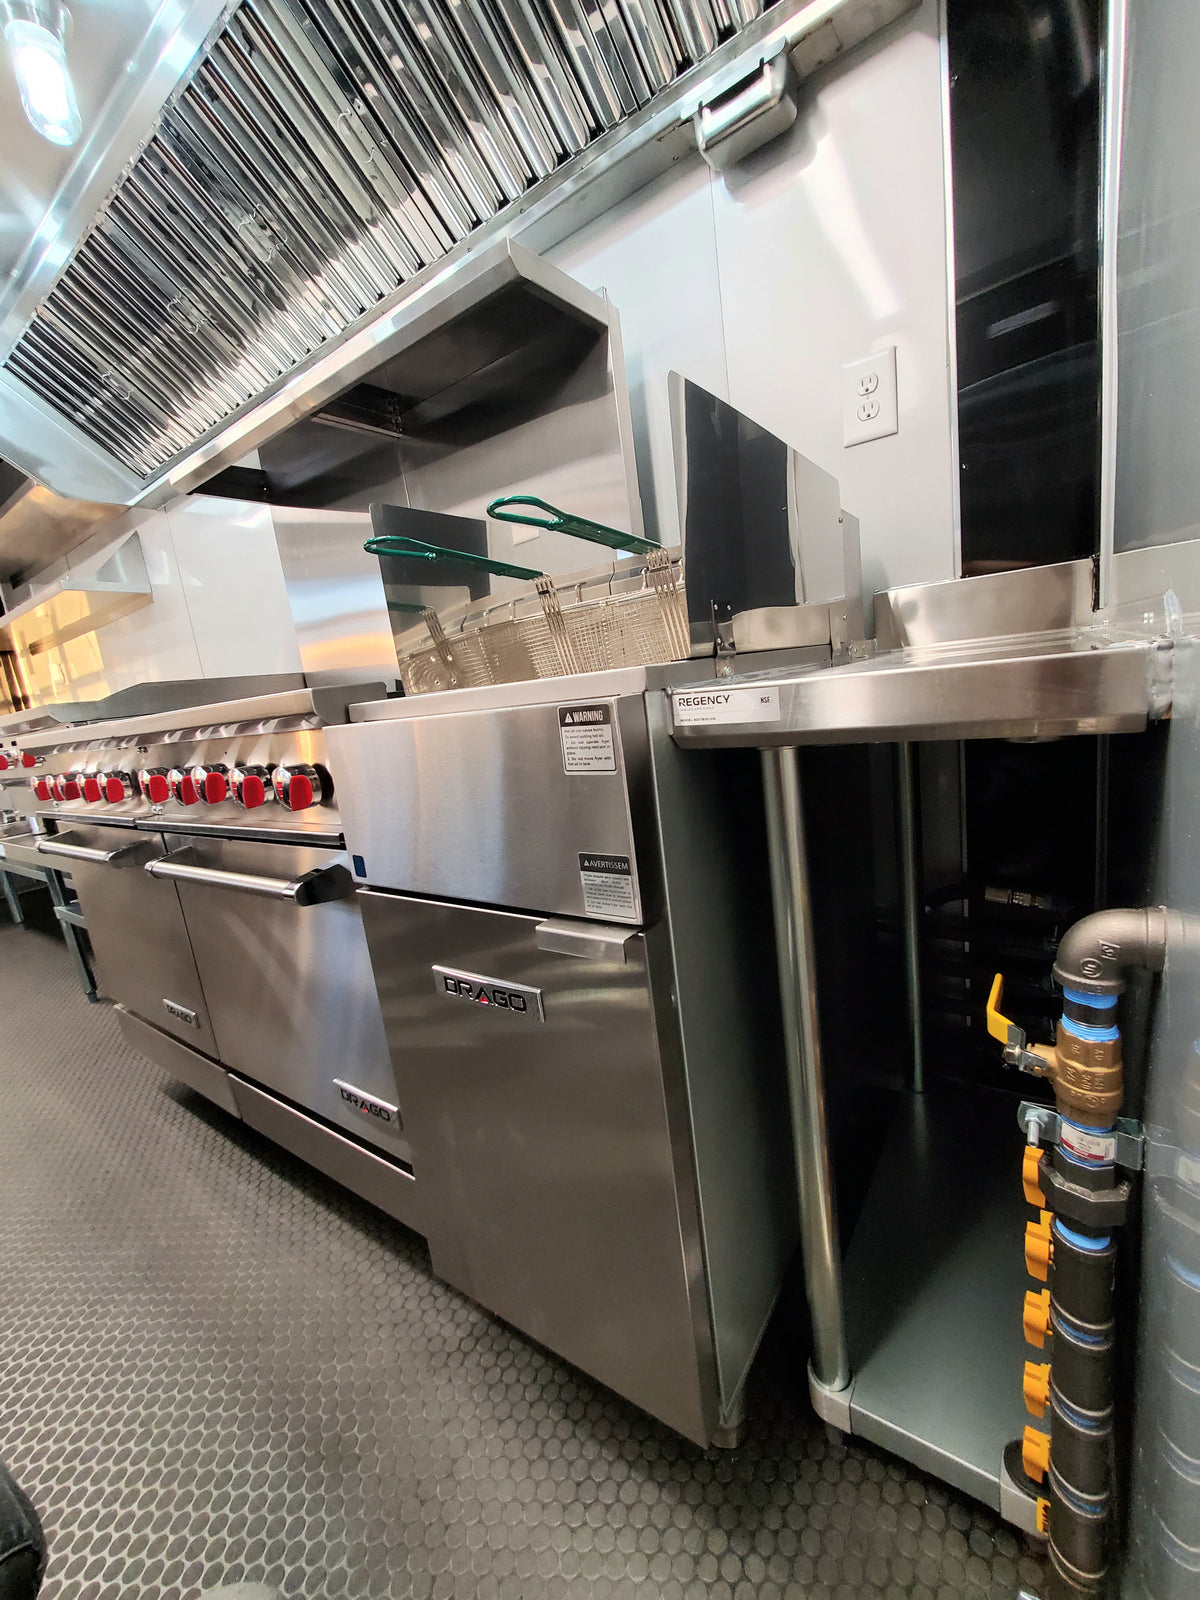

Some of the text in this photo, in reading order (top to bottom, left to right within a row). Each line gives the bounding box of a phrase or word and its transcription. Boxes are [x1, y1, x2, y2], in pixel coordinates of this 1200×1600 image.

[678, 694, 731, 707] REGENCY
[760, 696, 770, 704] NSF
[572, 710, 604, 722] WARNING
[589, 860, 628, 870] AVERTISSEM
[443, 976, 527, 1014] DRAGO
[340, 1087, 391, 1122] DRAGO
